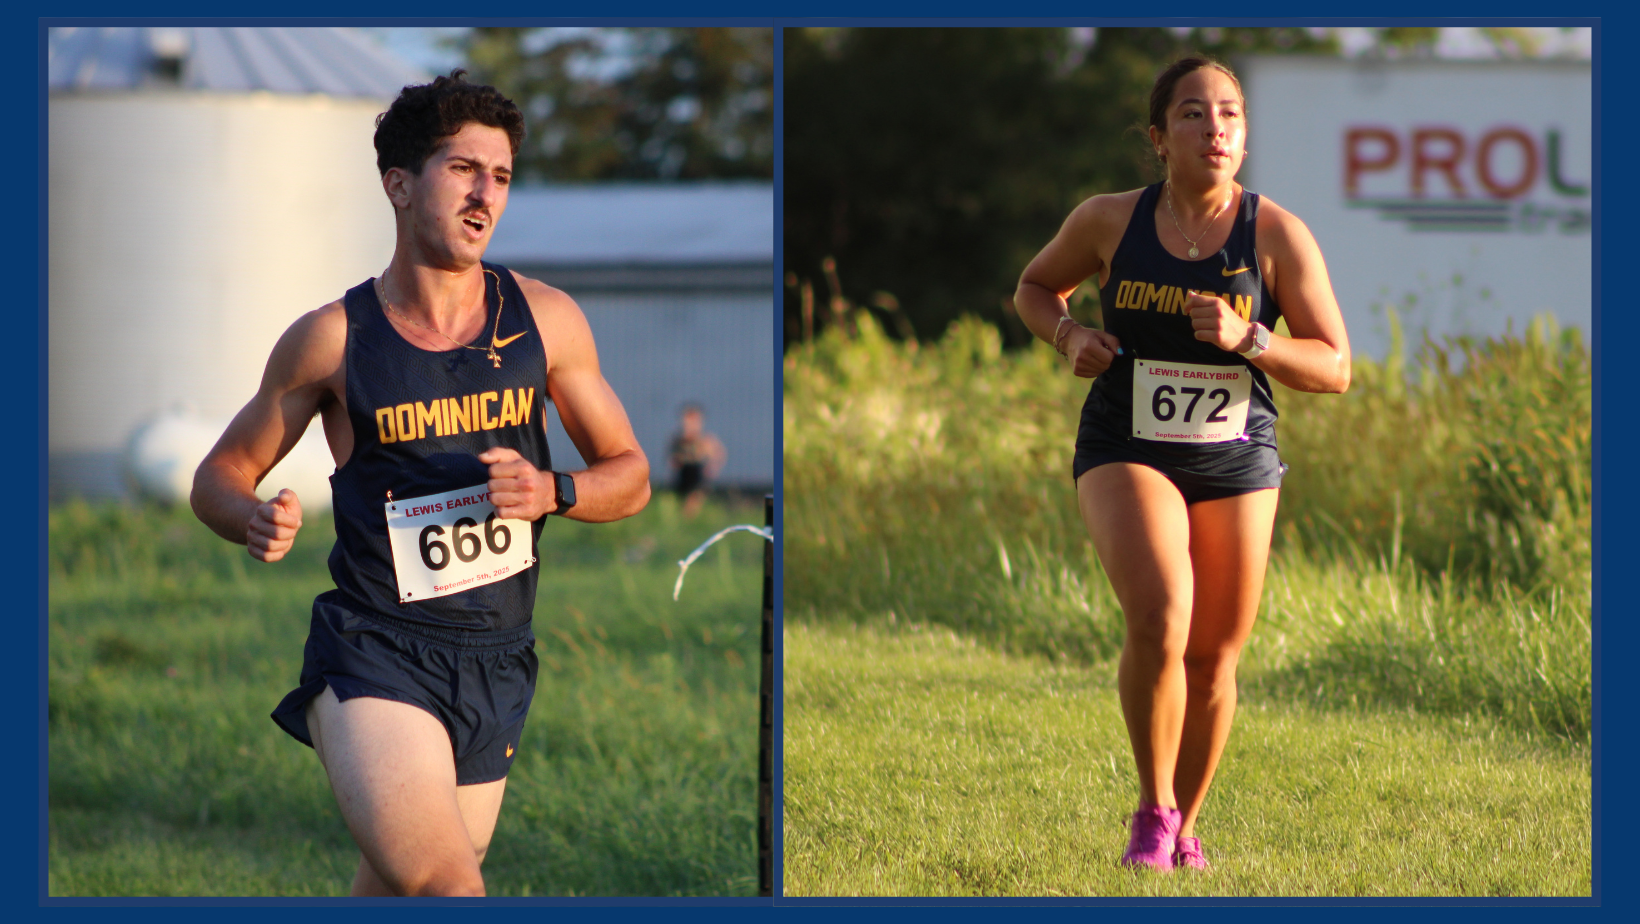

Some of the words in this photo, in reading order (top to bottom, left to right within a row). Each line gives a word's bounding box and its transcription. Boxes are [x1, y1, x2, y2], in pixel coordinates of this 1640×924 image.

[1115, 280, 1253, 323] DOMINN
[1149, 367, 1180, 378] LEWIS
[1182, 370, 1239, 381] EARLYBIRD
[376, 387, 534, 444] DOMINICAN
[1151, 384, 1231, 424] 672
[405, 502, 444, 518] LEWIS
[446, 491, 492, 510] EARLY
[418, 511, 512, 571] 666
[433, 577, 475, 592] September
[476, 572, 492, 581] 5th,
[493, 566, 510, 577] 2025
